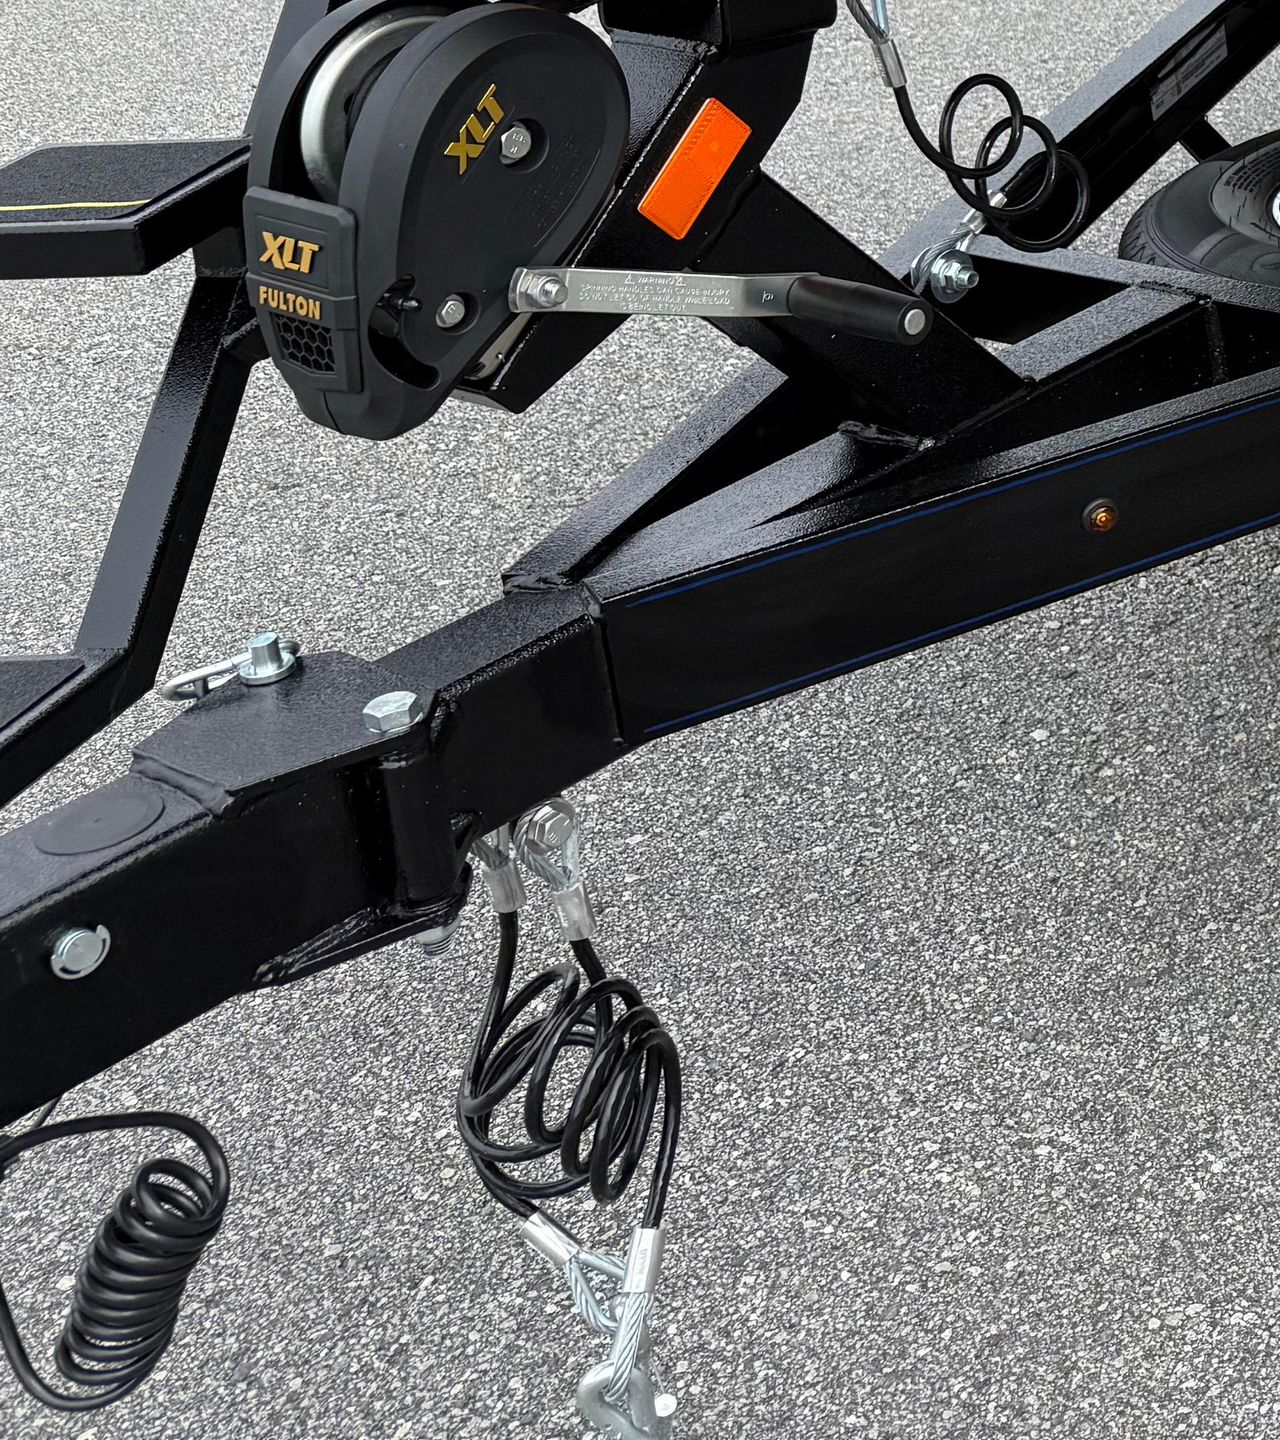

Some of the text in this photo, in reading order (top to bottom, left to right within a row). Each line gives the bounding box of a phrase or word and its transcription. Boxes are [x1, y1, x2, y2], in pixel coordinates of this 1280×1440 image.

[443, 83, 508, 176] XLT
[258, 231, 322, 274] XLT
[257, 285, 323, 321] FULTON
